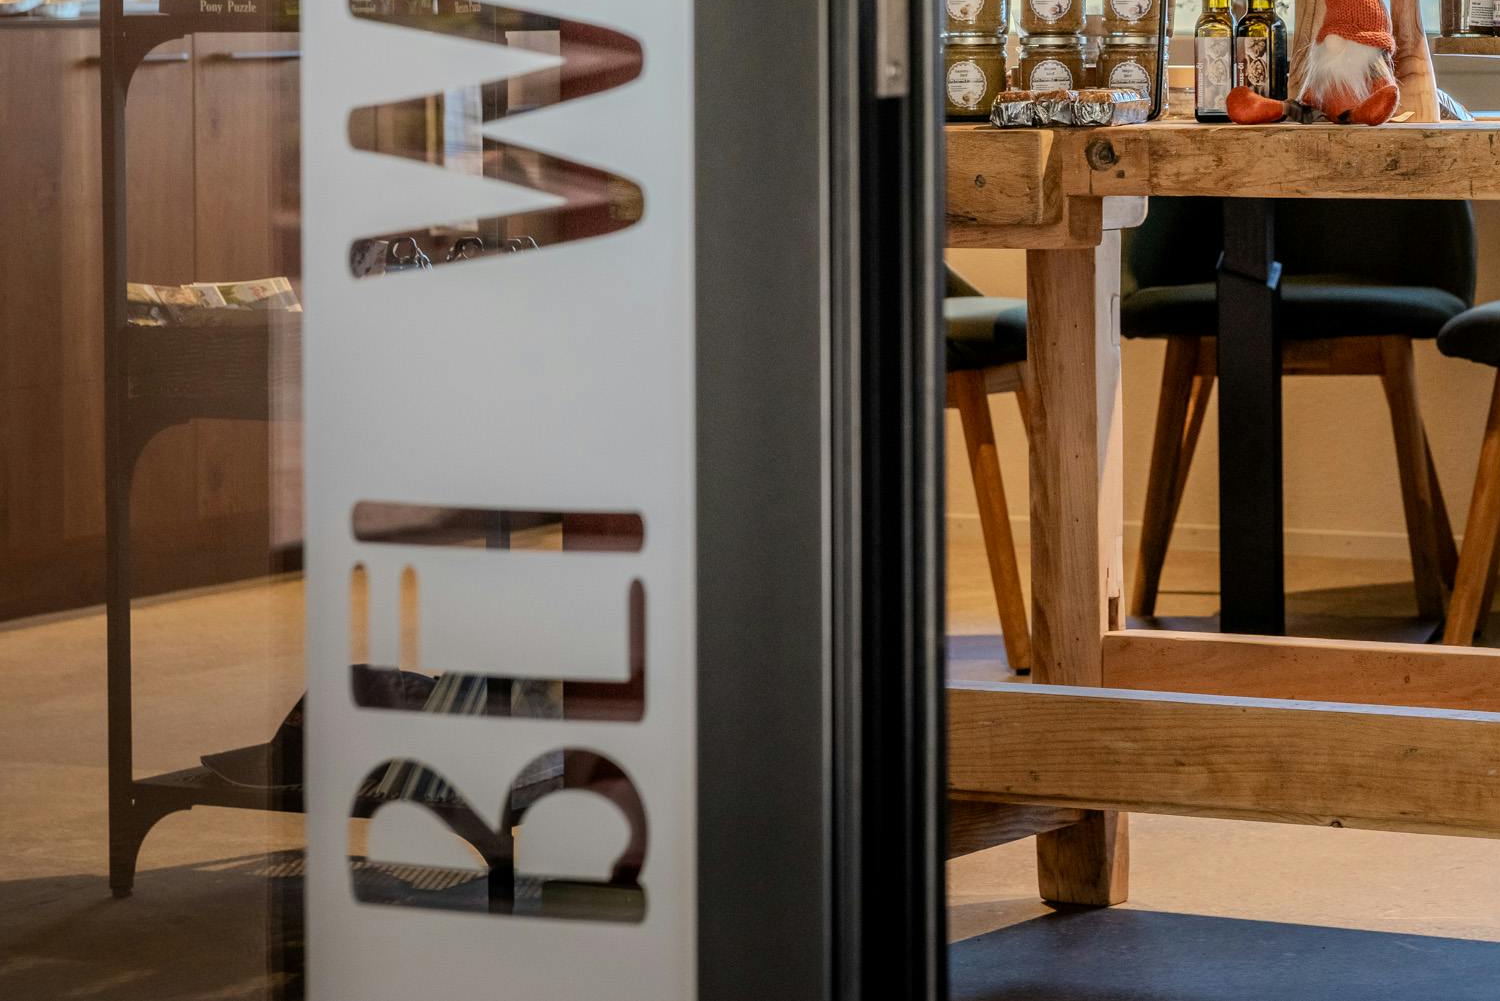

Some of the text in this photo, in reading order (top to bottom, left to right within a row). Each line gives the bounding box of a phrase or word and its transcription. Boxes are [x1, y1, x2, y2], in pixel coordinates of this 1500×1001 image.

[200, 0, 257, 15] Pony Puzzle
[348, 499, 649, 924] BEI
